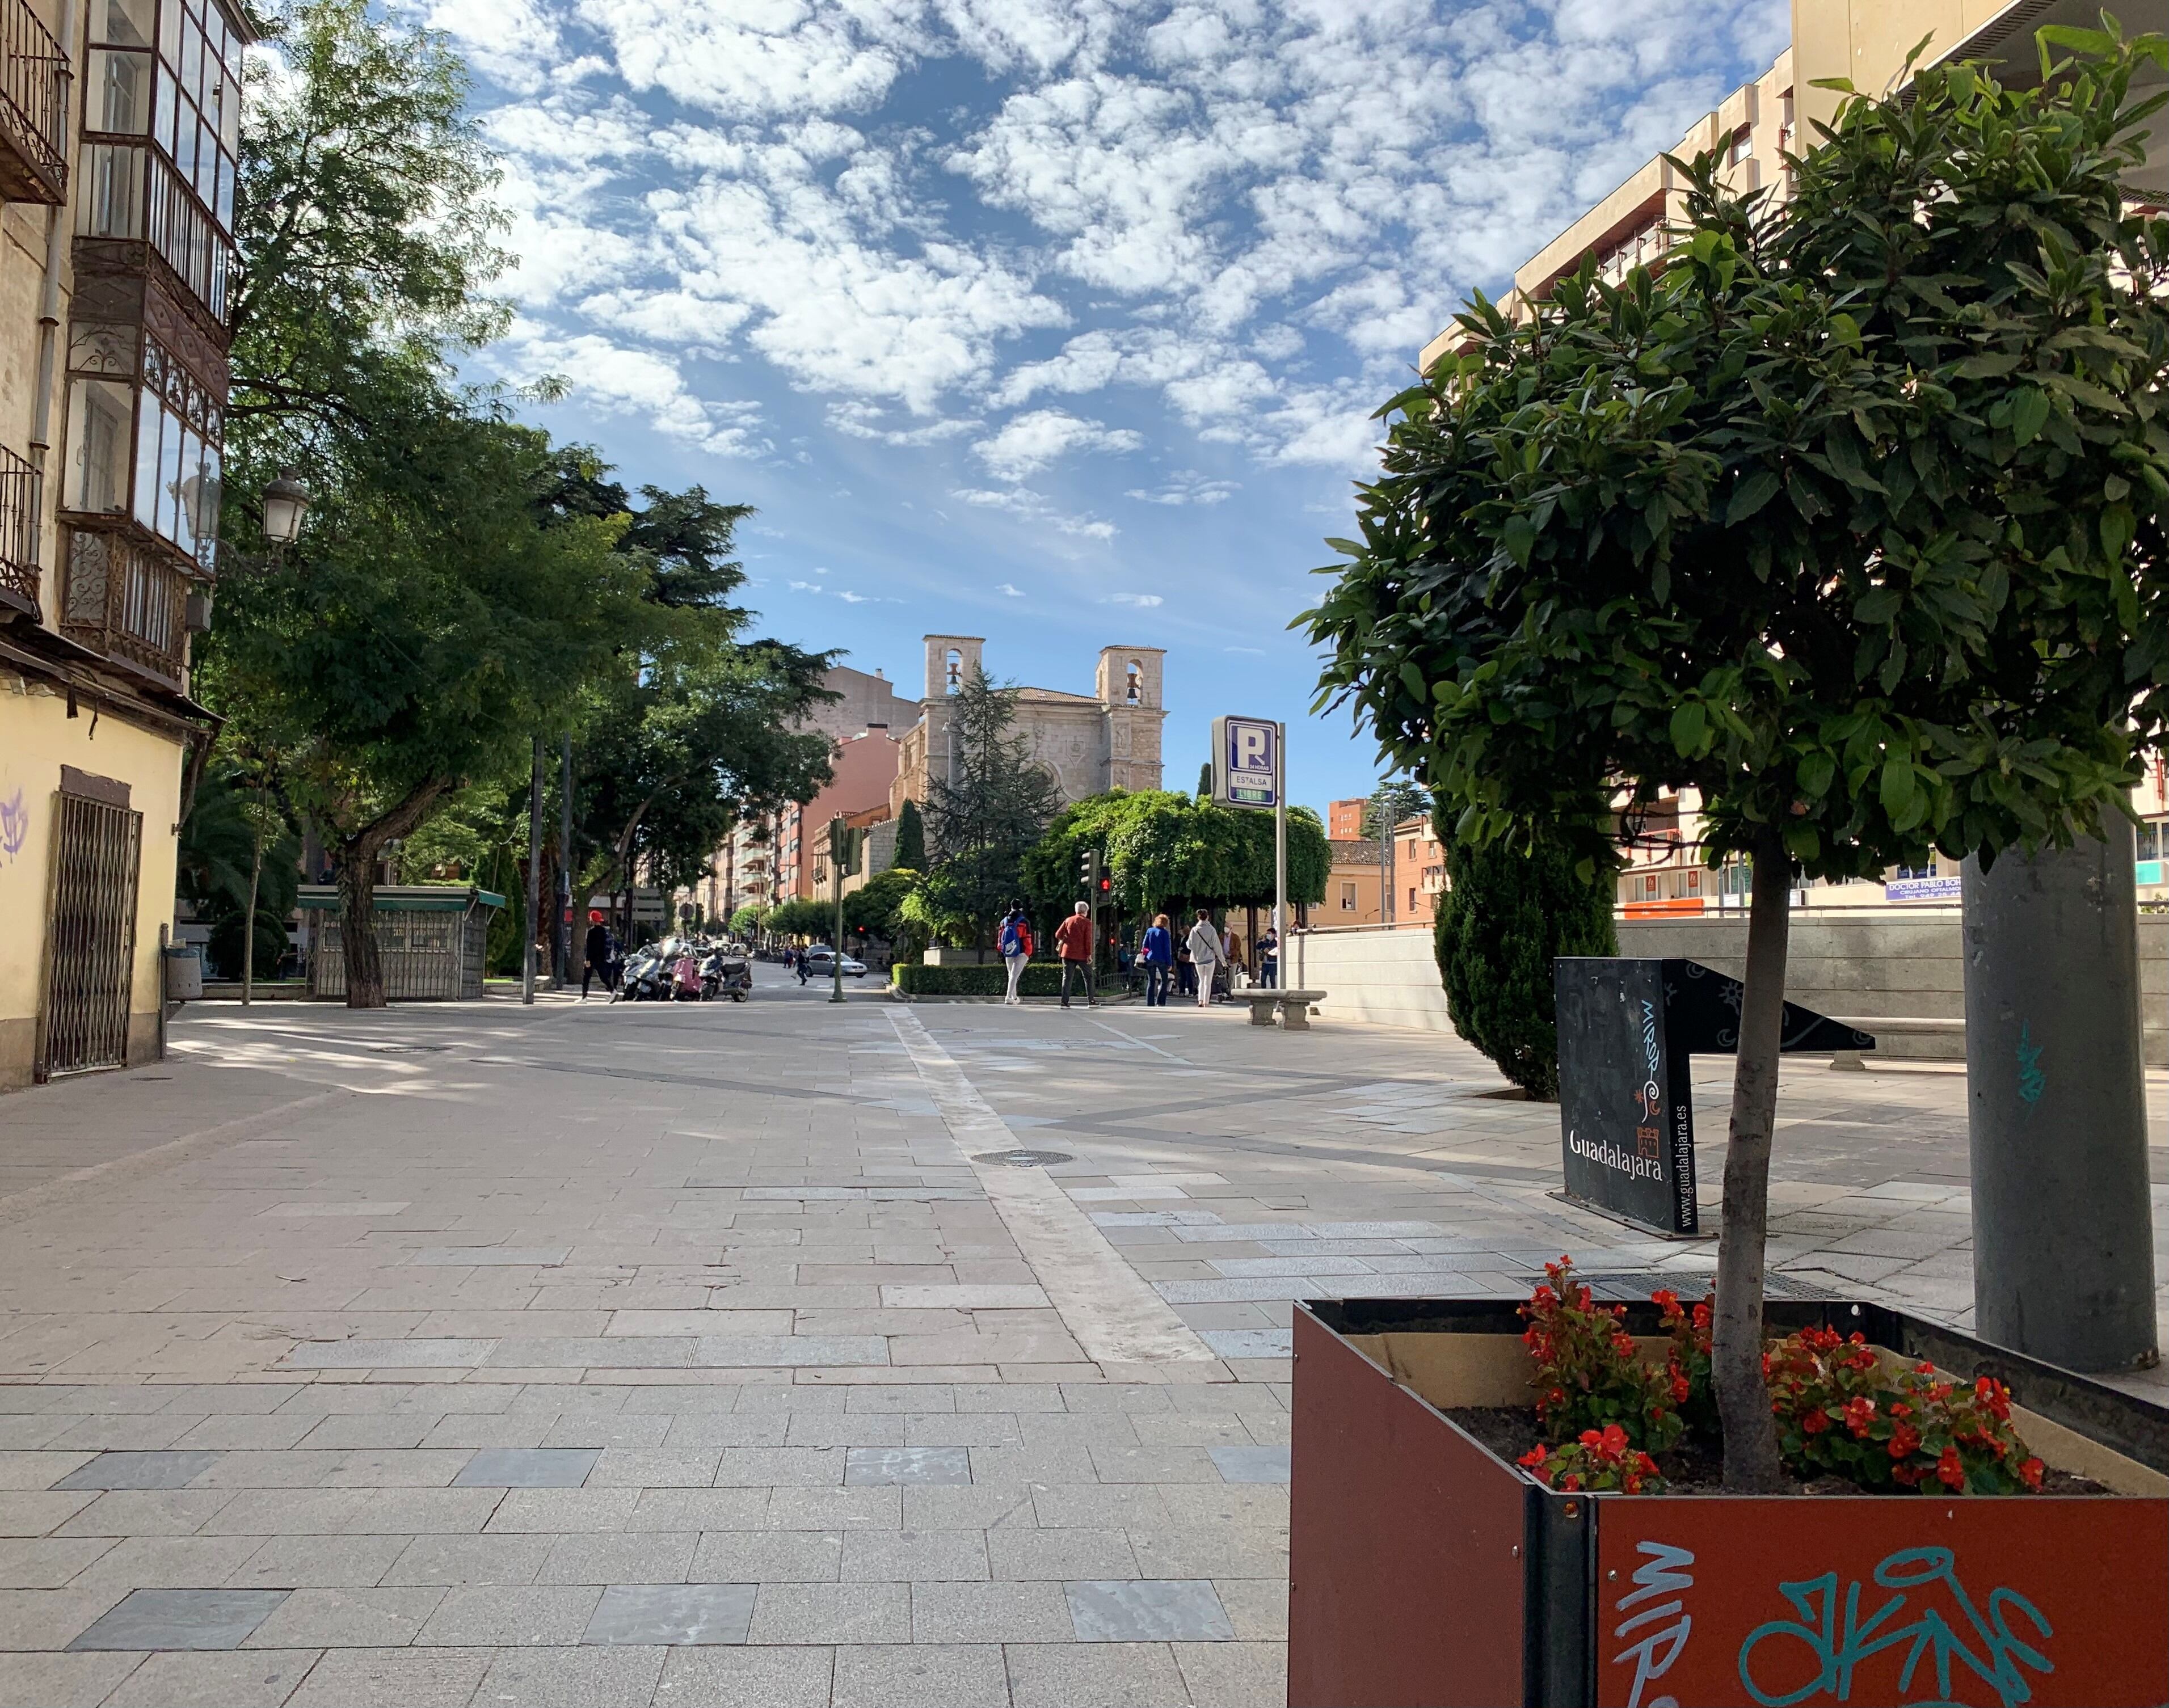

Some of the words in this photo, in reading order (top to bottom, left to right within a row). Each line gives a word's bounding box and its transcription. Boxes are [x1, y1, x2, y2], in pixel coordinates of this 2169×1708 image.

[1237, 727, 1265, 769] P
[1236, 775, 1267, 786] ESTALSA
[1239, 789, 1262, 800] LIBRE
[1920, 880, 1943, 889] PABLO
[1569, 1129, 1663, 1182] Guadalajara
[1675, 1105, 1694, 1228] www.guadalajara.es
